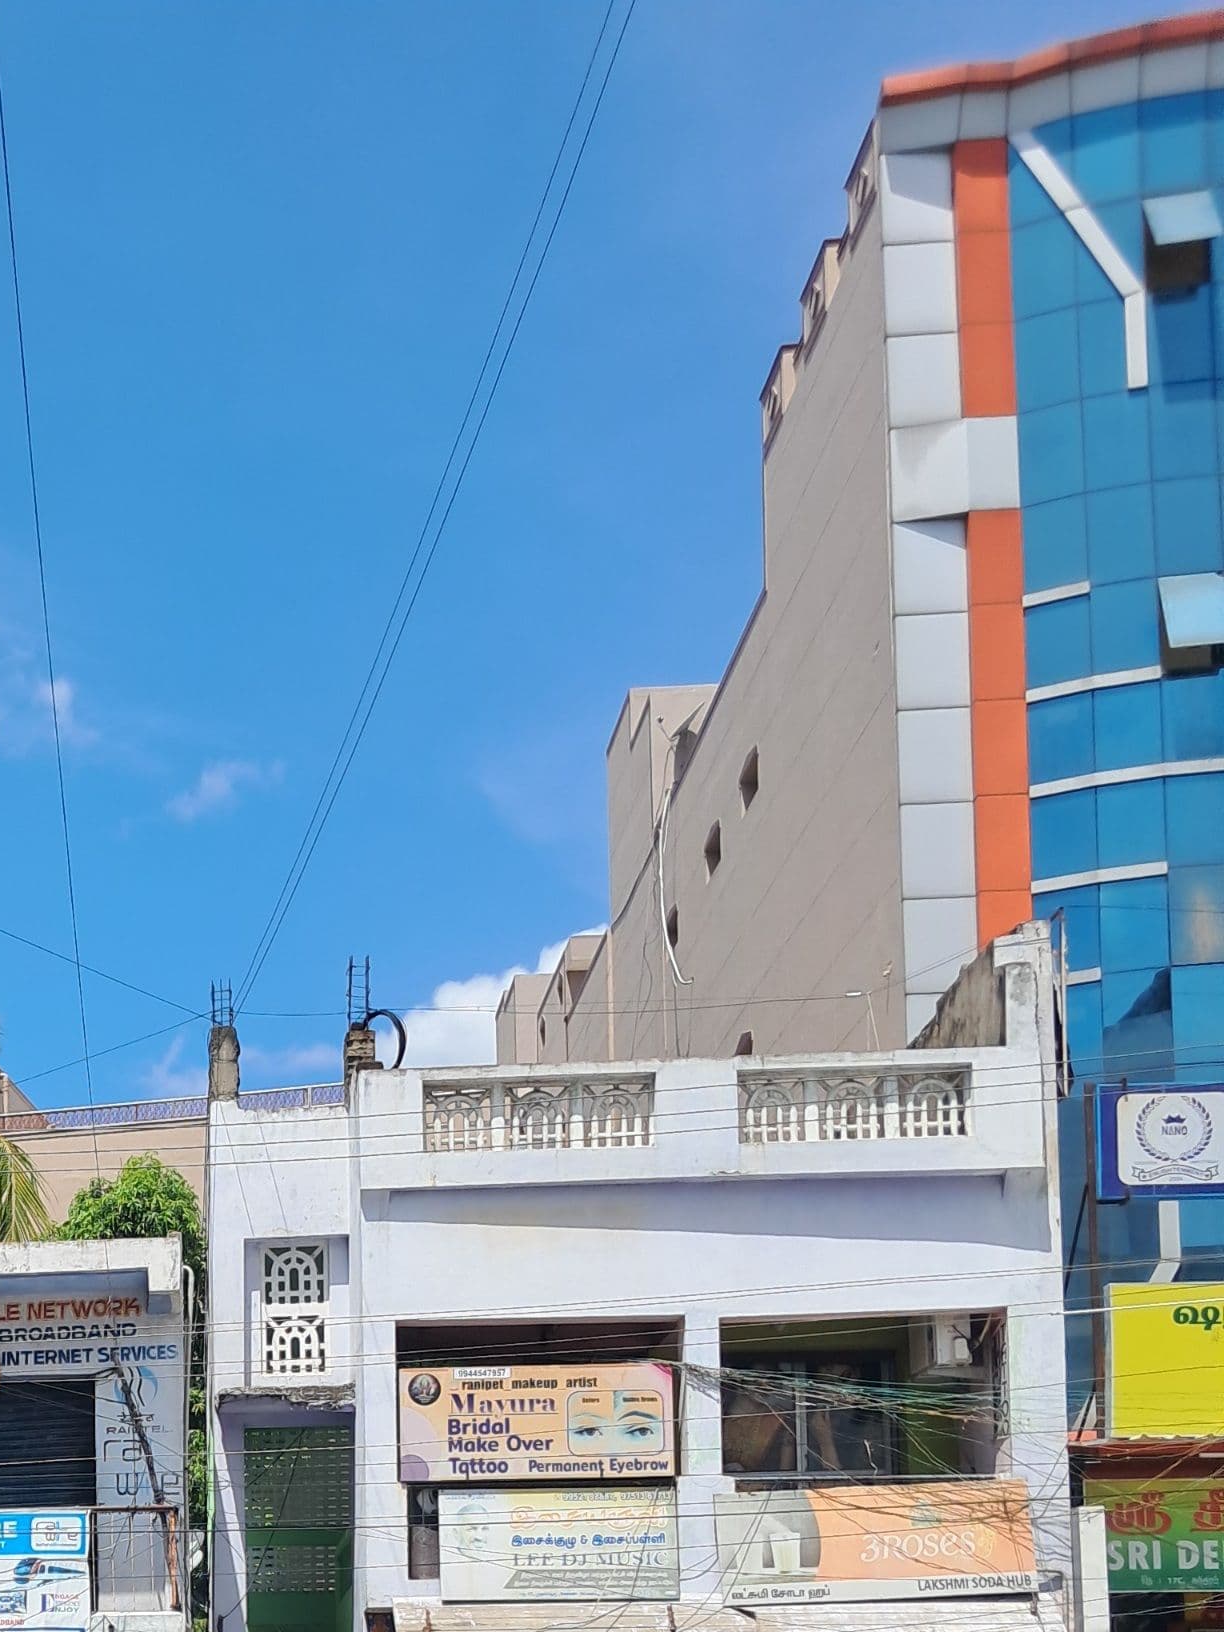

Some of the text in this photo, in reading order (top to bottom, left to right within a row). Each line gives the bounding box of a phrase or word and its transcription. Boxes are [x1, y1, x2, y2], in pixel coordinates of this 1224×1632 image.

[1161, 1126, 1188, 1136] NANO
[27, 1298, 141, 1320] NETWORK
[0, 1322, 138, 1343] BROADBAND
[0, 1348, 90, 1367] INTERNET
[97, 1344, 176, 1363] SERVICES
[450, 1392, 558, 1418] Mayura
[448, 1417, 510, 1436] Bridal
[448, 1434, 554, 1453] Make Over
[448, 1457, 669, 1474] Tattoo Permanent Eyebrow
[512, 1552, 554, 1567] LEE
[593, 1550, 667, 1566] MUSIC
[1107, 1540, 1224, 1571] SRI DE
[917, 1573, 1032, 1592] LAKSHMI SODA HUB
